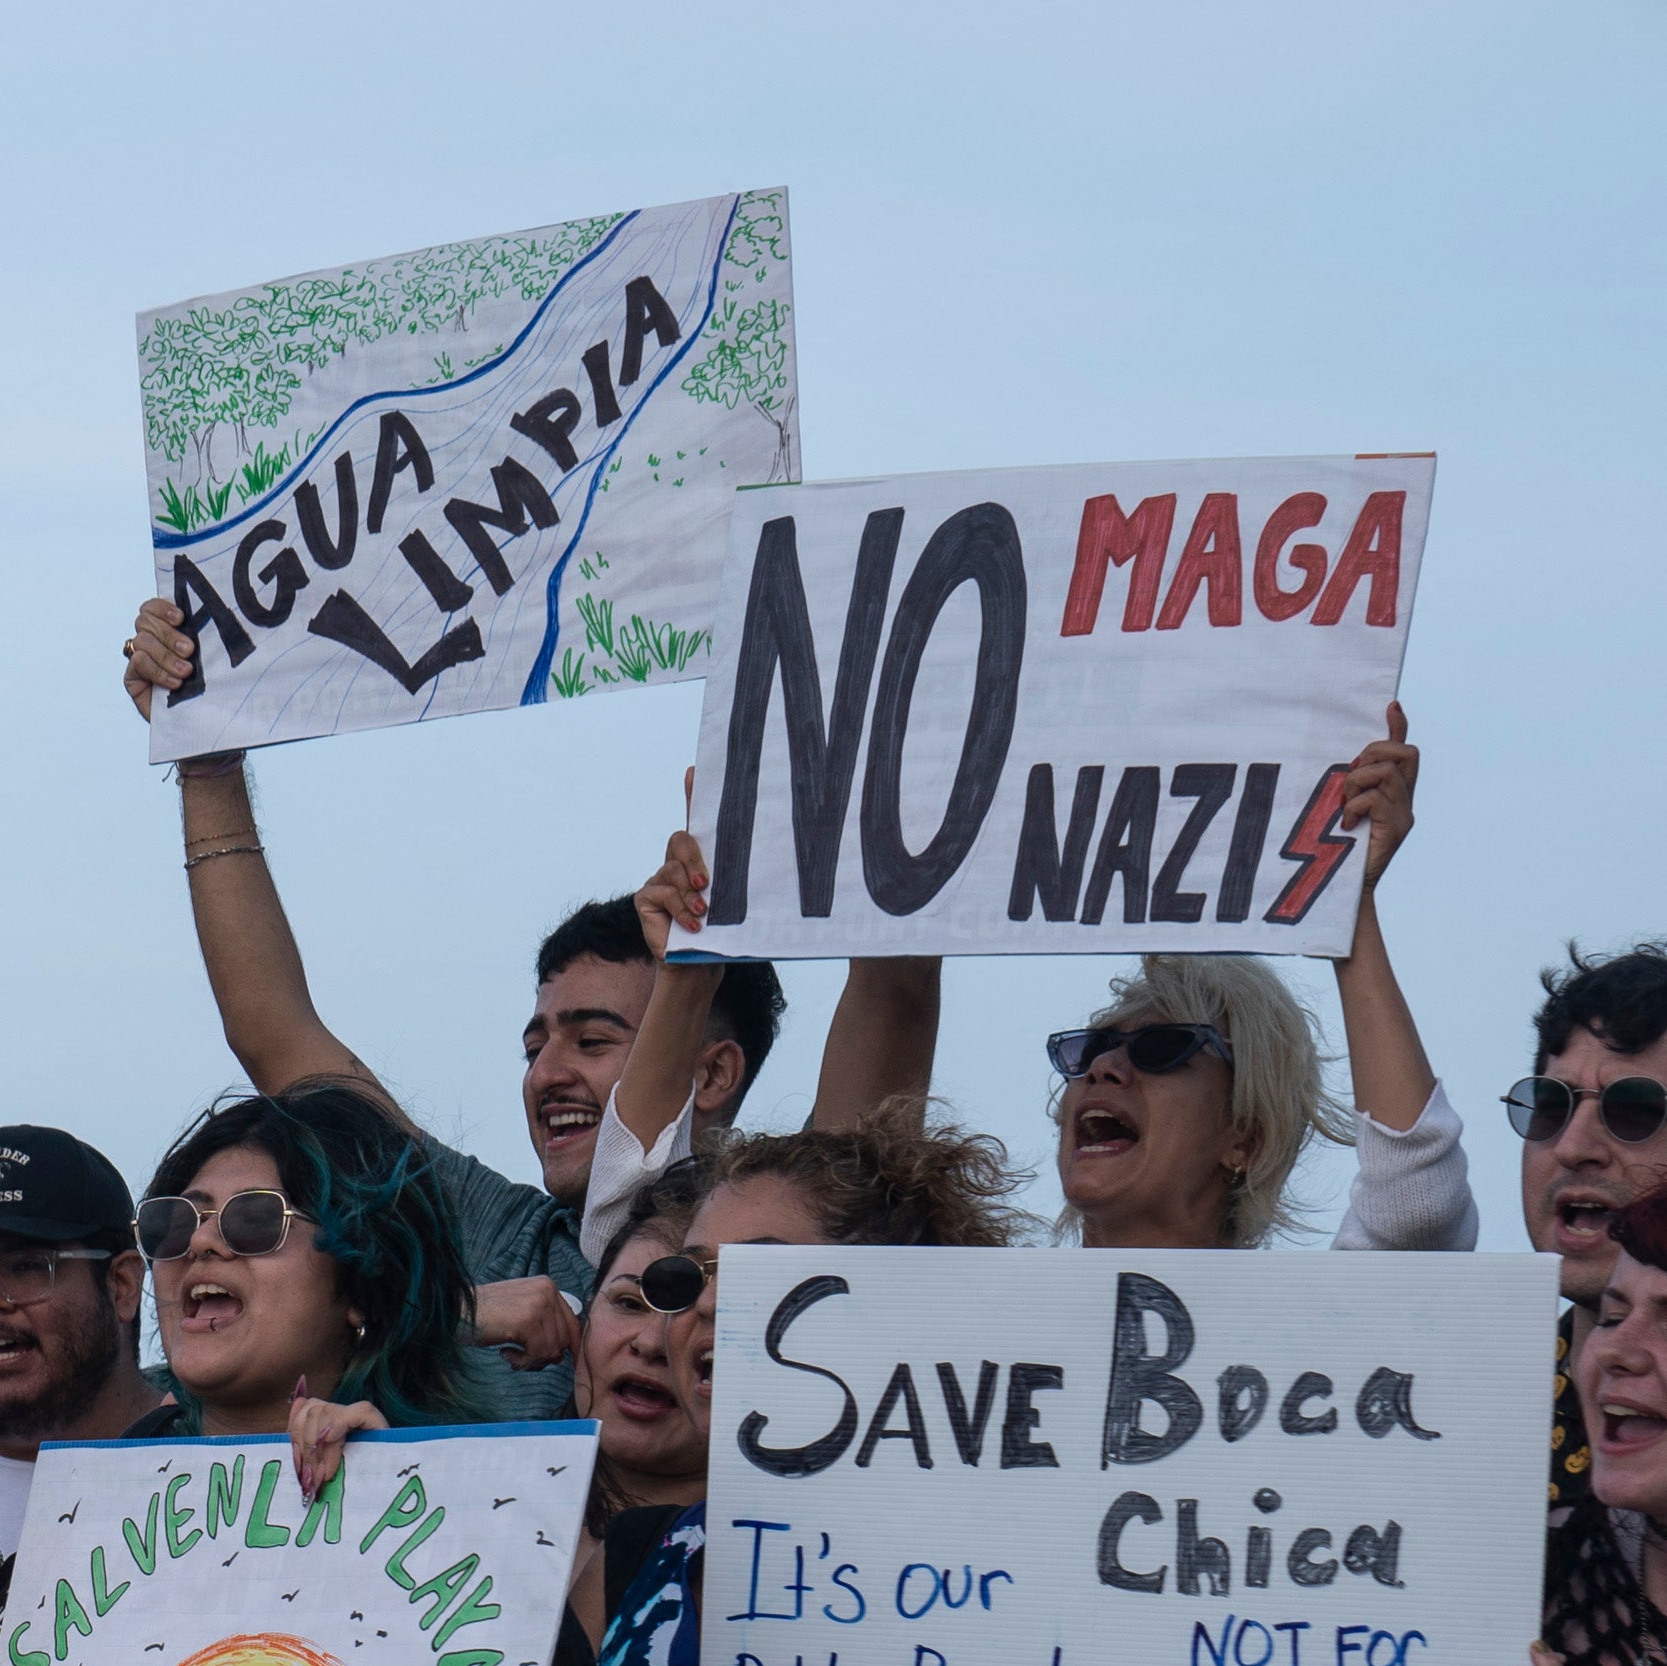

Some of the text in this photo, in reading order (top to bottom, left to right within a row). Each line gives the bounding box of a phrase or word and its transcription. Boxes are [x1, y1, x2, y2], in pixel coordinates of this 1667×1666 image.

[167, 409, 435, 708] AGUA
[308, 275, 683, 696] LIMPIA
[1059, 491, 1407, 637] MAGA
[706, 502, 1028, 926] NO
[737, 1271, 1442, 1479] SAVE Boca
[245, 1454, 346, 1548] LA
[726, 1519, 866, 1624] It's
[1097, 1489, 1406, 1598] Chica
